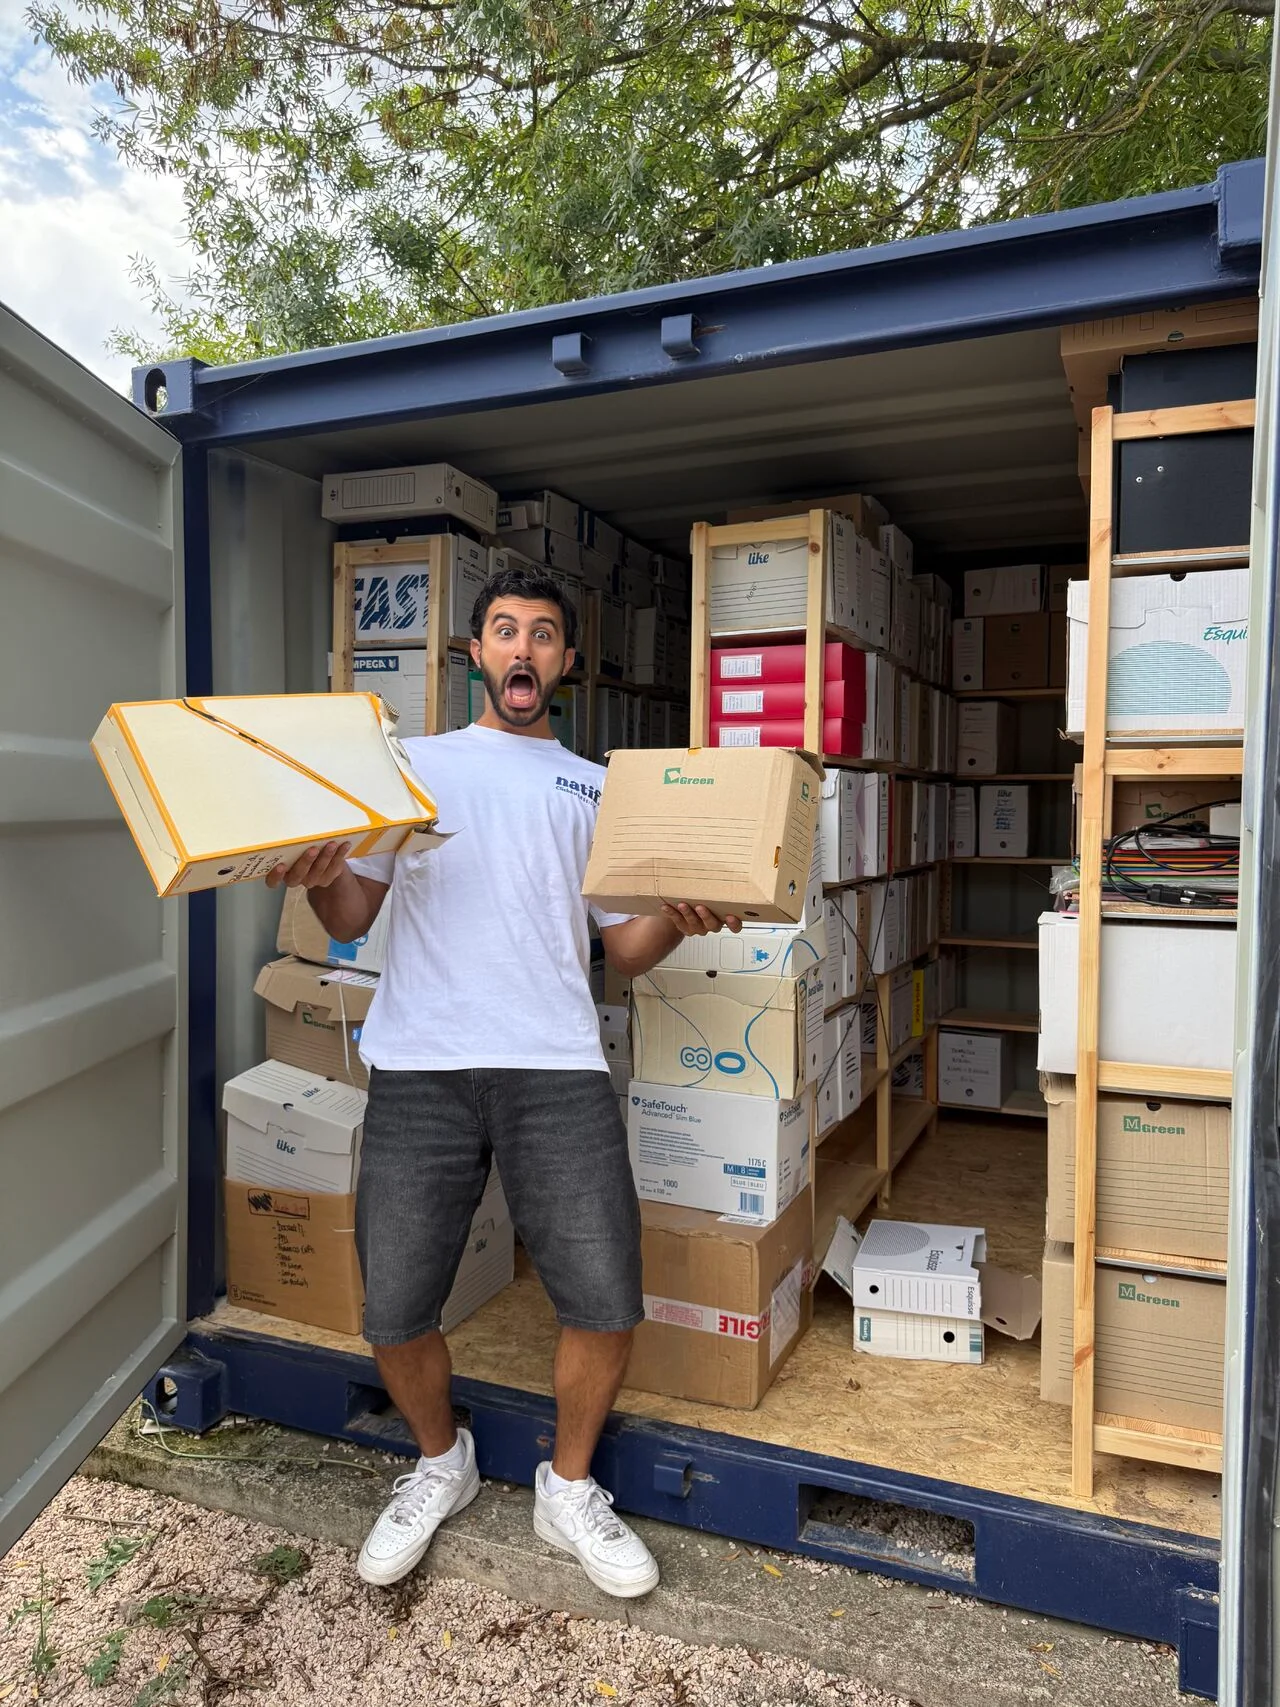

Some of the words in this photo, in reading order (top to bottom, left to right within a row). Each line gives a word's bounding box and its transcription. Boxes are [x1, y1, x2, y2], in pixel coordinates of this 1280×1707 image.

[747, 551, 769, 566] like
[1203, 625, 1248, 646] Esqui
[679, 776, 715, 785] Green
[555, 776, 602, 804] natif
[302, 1086, 321, 1099] like
[688, 1115, 702, 1123] Blue
[276, 1139, 296, 1155] like
[662, 1179, 679, 1189] 1000
[925, 1249, 944, 1272] Esquisse
[966, 1286, 975, 1315] Esquisse
